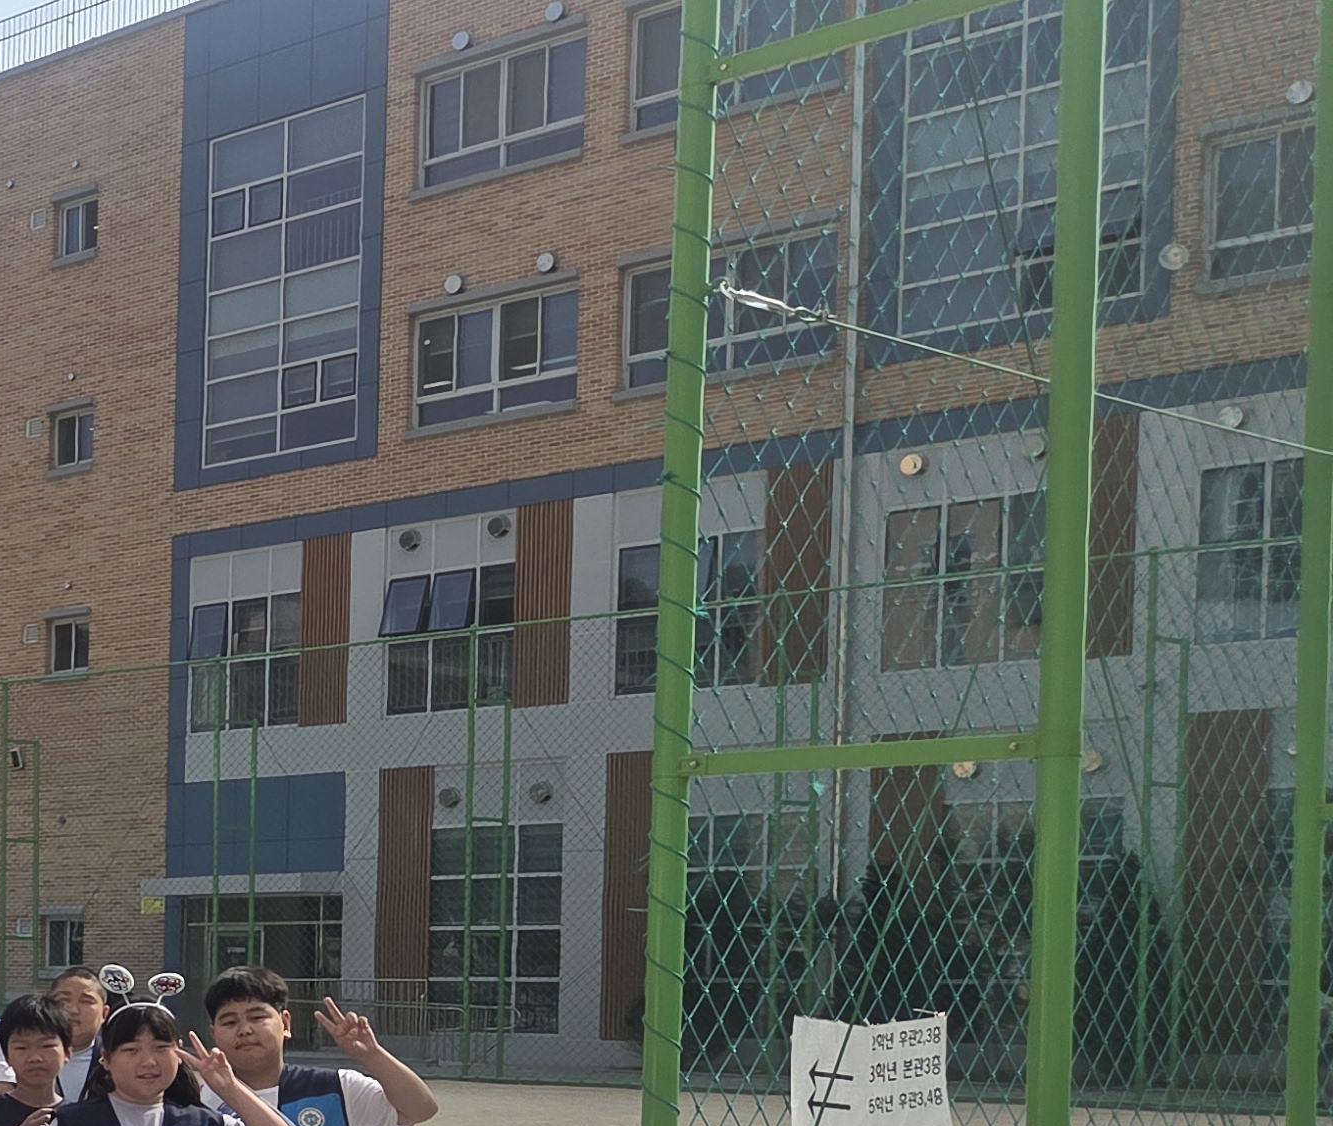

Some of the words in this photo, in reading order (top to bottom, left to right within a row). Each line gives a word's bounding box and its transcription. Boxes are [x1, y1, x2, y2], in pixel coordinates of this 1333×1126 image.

[869, 1061, 897, 1083] 3학년
[903, 1054, 942, 1080] 본관3층
[869, 1094, 894, 1115] 5학년
